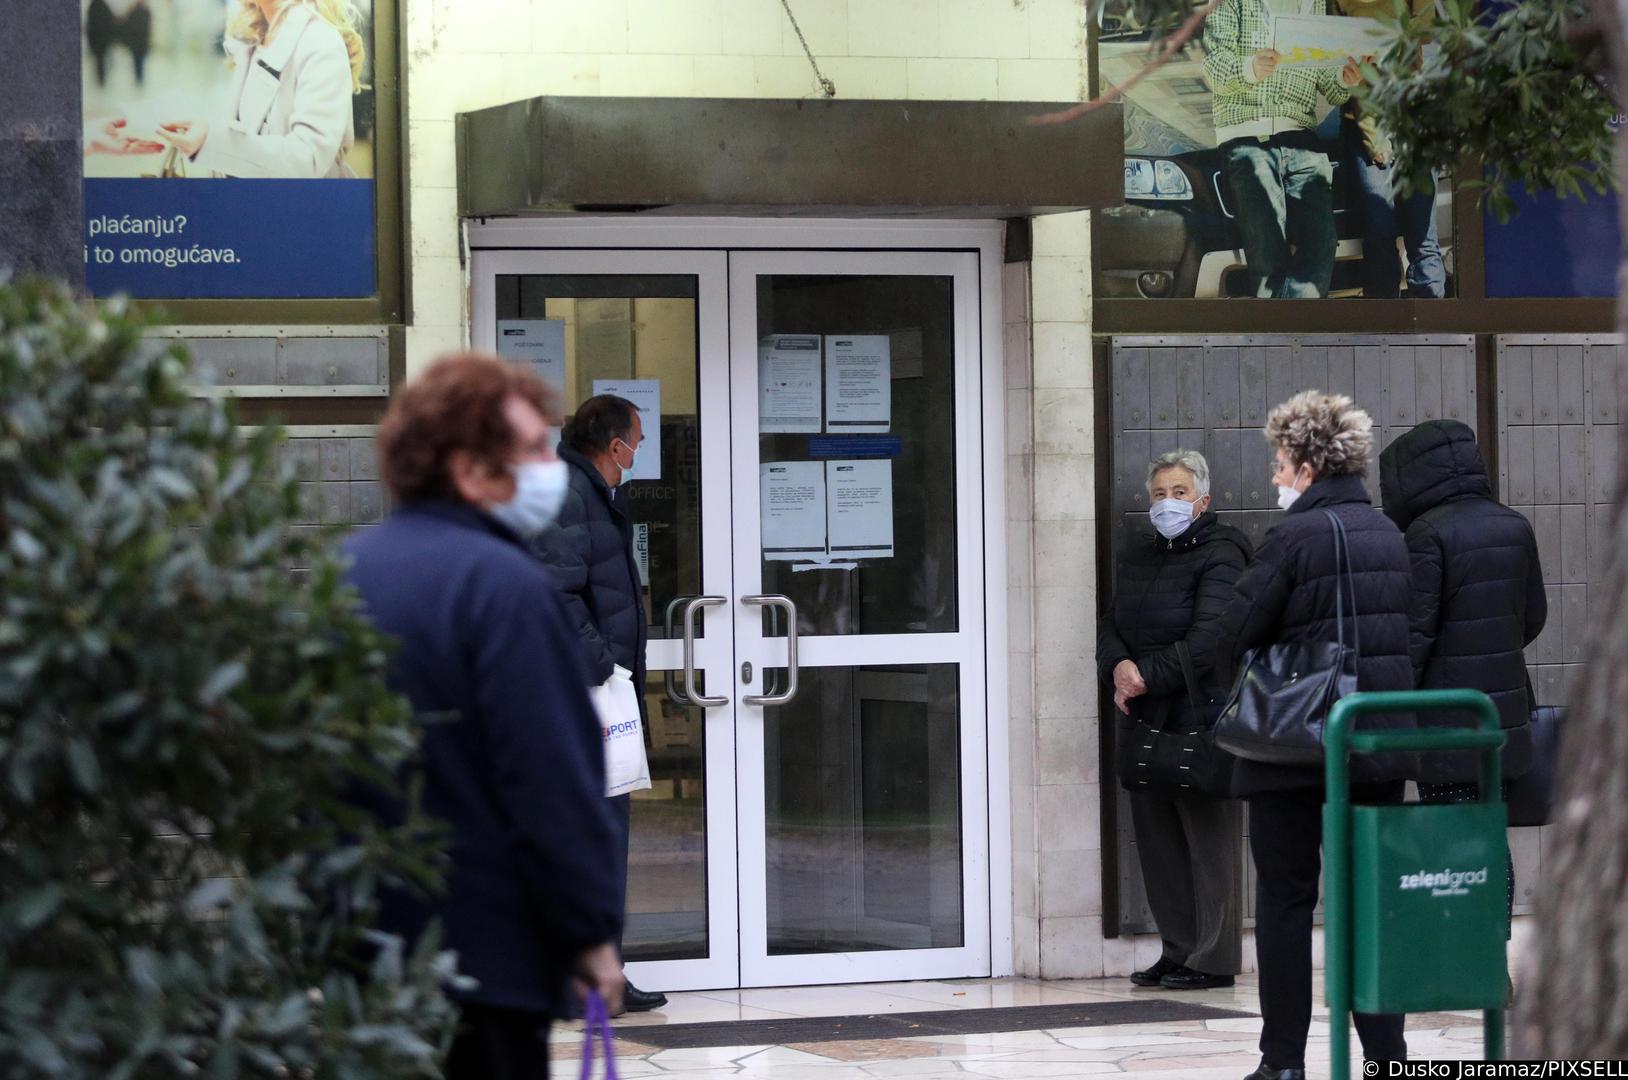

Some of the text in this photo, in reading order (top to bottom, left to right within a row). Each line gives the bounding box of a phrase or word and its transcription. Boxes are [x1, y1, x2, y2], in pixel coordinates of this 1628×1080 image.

[89, 214, 187, 238] plaćanju?
[94, 245, 115, 263] to
[120, 244, 241, 268] omogućava.
[628, 486, 673, 500] OFFICE
[1399, 868, 1487, 889] zelenigrad
